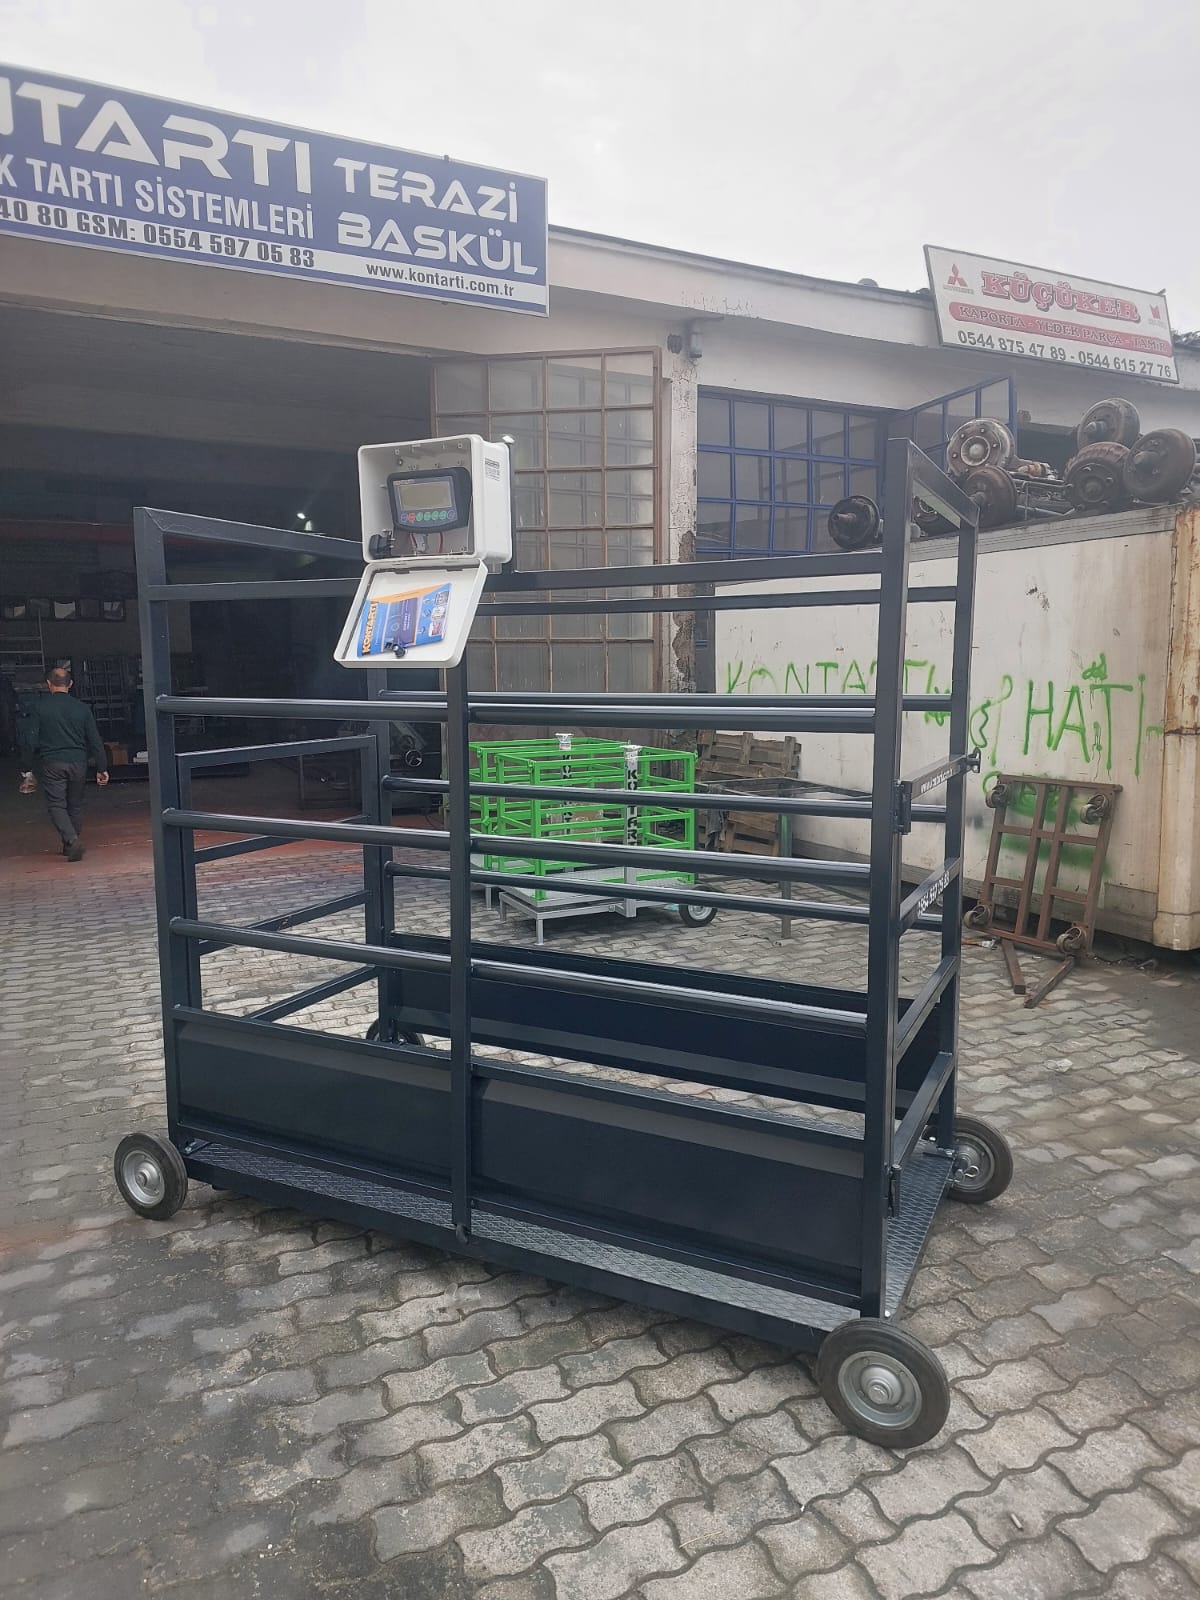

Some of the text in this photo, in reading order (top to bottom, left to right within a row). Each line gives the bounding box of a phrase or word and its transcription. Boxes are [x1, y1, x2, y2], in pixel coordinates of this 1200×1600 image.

[0, 77, 311, 194] TARTI
[25, 157, 123, 207] TARTI
[134, 176, 314, 239] SİSTEMLERİ
[333, 157, 518, 223] TERAZİ
[37, 205, 68, 229] 80
[77, 211, 136, 240] GSM:
[143, 224, 202, 251] 0554
[209, 234, 250, 258] 597
[257, 242, 283, 263] 05
[290, 248, 315, 268] 83
[337, 211, 538, 276] BASKÜL
[366, 263, 515, 297] www.kontarti.com.tr
[981, 271, 1141, 324] KÜÇÜKER
[959, 306, 1026, 327] KAPORTA
[957, 330, 995, 349] 0544
[998, 337, 1025, 354] 875
[1029, 343, 1045, 358] 47
[1050, 346, 1066, 361] 89
[1078, 350, 1110, 369] 0544
[1113, 356, 1136, 373] 615
[1139, 360, 1154, 375] 27
